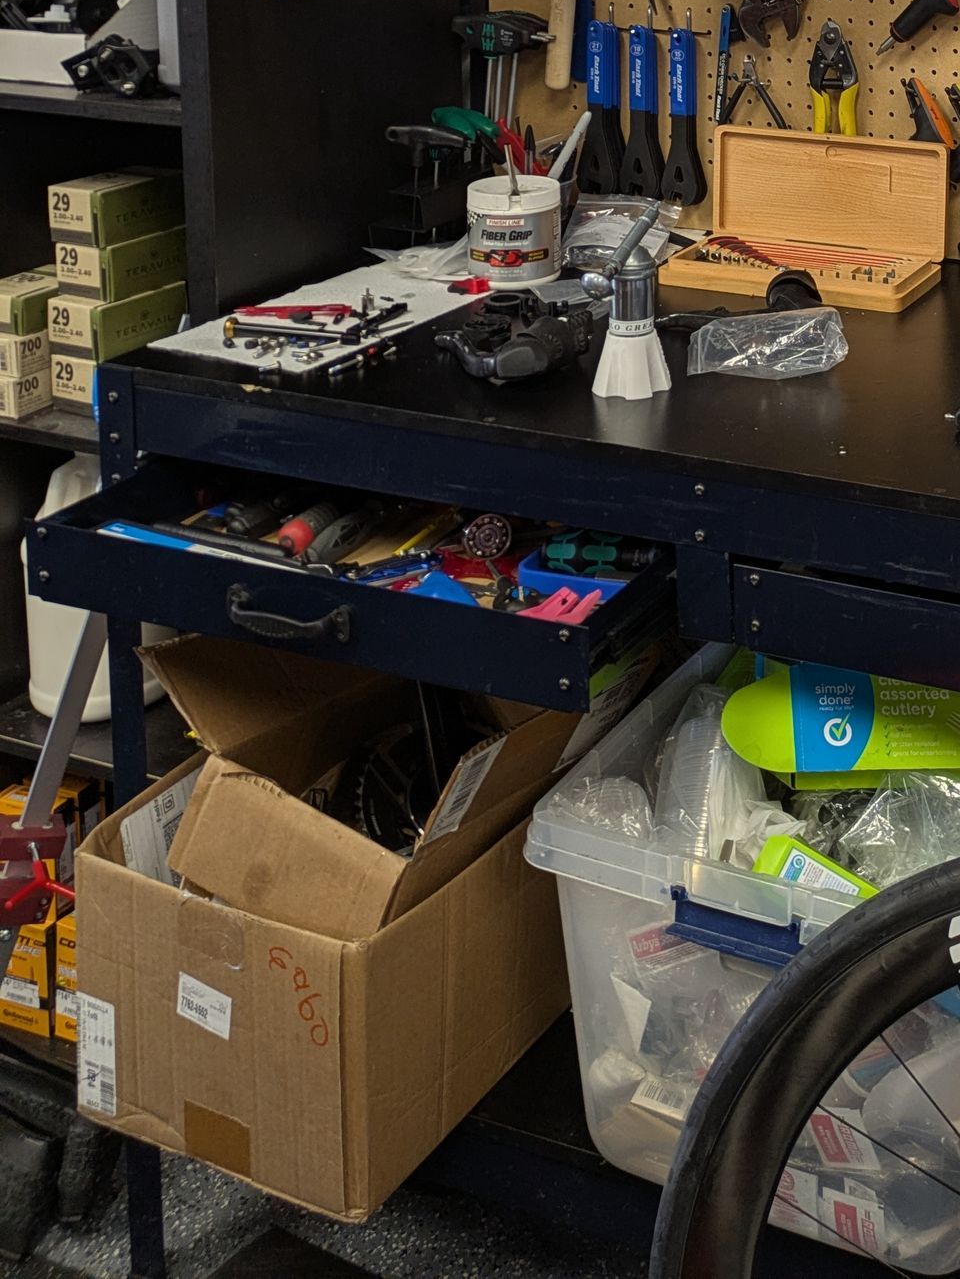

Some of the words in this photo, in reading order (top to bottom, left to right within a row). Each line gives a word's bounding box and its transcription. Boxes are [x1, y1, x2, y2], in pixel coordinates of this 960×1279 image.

[52, 193, 70, 212] 29
[481, 229, 506, 241] FIBER
[509, 230, 533, 241] GRIP
[60, 247, 78, 266] 29
[52, 306, 70, 326] 29
[20, 336, 41, 353] 700
[55, 362, 73, 381] 29
[17, 376, 39, 394] 700
[815, 683, 855, 696] simply
[880, 688, 949, 700] assorted
[819, 696, 850, 705] done
[882, 703, 936, 717] cutlery
